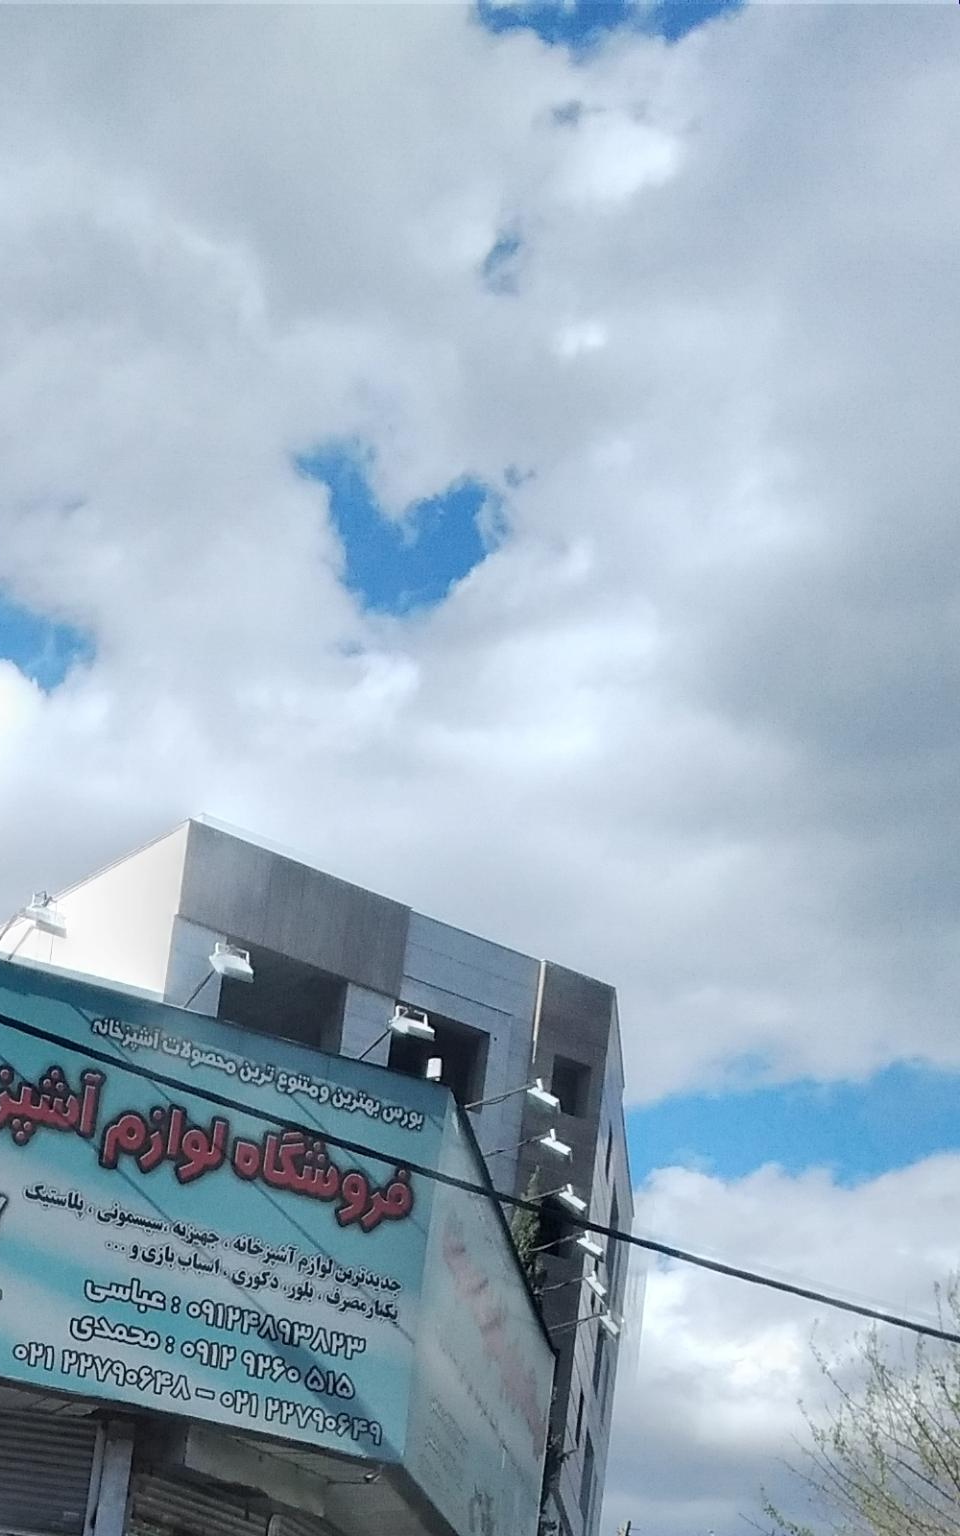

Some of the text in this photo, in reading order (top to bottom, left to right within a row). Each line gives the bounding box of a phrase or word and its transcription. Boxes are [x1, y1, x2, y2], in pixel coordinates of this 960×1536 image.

[91, 1017, 160, 1051] آشپزخانه
[162, 1036, 237, 1073] محصولات
[239, 1060, 275, 1087] ترین
[331, 1091, 381, 1118] بهترین
[382, 1106, 425, 1131] بورس
[98, 1103, 229, 1184] لوازم
[234, 1131, 415, 1234] فروشگاه
[23, 1184, 84, 1218] پلاستیک
[140, 1245, 176, 1270] بازی
[177, 1252, 221, 1276] اسباب
[232, 1234, 297, 1266] آشپزخانه
[230, 1269, 280, 1291] دکوری
[298, 1257, 334, 1279] لوازم
[334, 1265, 402, 1296] جدیدترین
[83, 1277, 167, 1314] عباسی
[69, 1314, 161, 1350] محمدی
[186, 1299, 367, 1360] ۰۹۱۲۴۸۹۳۸۲۳
[180, 1337, 237, 1371] ۰۹۱۲
[241, 1350, 301, 1384] ۹۲۶۰
[12, 1341, 55, 1372] ۰۲۱
[60, 1348, 192, 1401] ۲۲۷۹۰۶۴۸
[219, 1389, 259, 1418] ۰۲۱
[264, 1396, 383, 1447] ۲۲۷۹۰۶۴۹
[304, 1365, 357, 1401] ۵۱۵
